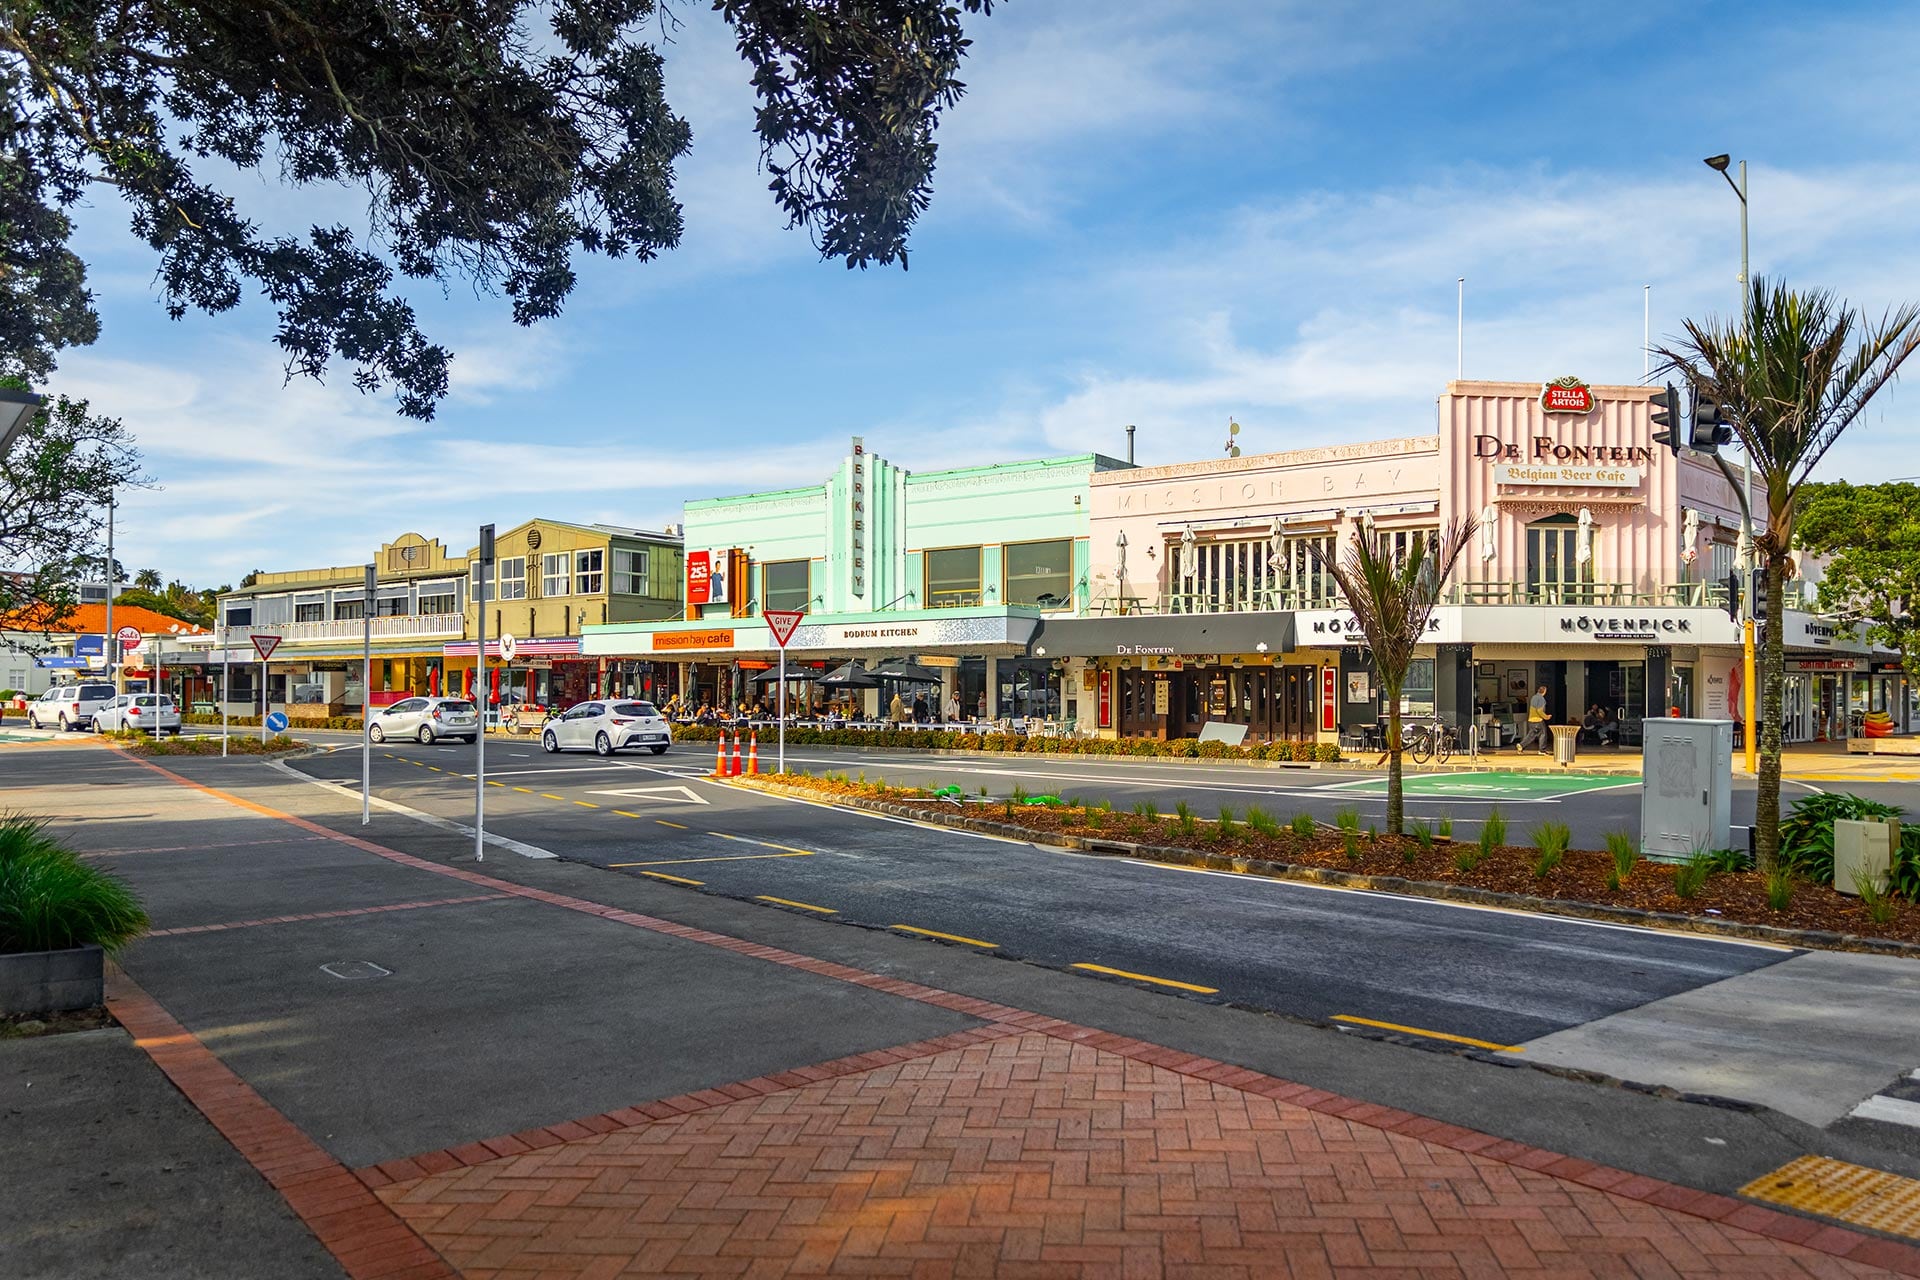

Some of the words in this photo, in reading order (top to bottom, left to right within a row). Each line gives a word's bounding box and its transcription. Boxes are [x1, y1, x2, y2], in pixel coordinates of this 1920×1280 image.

[1551, 390, 1585, 399] STELLA
[1551, 398, 1585, 407] ARTOIS
[1507, 467, 1558, 482] Belgian
[1561, 469, 1592, 481] Beer
[1596, 470, 1626, 483] Cafe
[1117, 480, 1283, 511] MISSION
[1322, 469, 1402, 493] BAY
[854, 445, 863, 587] BERKELEY
[775, 616, 792, 625] GIVE
[1560, 616, 1689, 630] MÖVENPICK
[655, 636, 689, 646] mission
[689, 634, 706, 647] bay
[707, 632, 730, 644] cafe
[843, 630, 878, 638] BODRUM
[880, 628, 918, 637] KITCHEN
